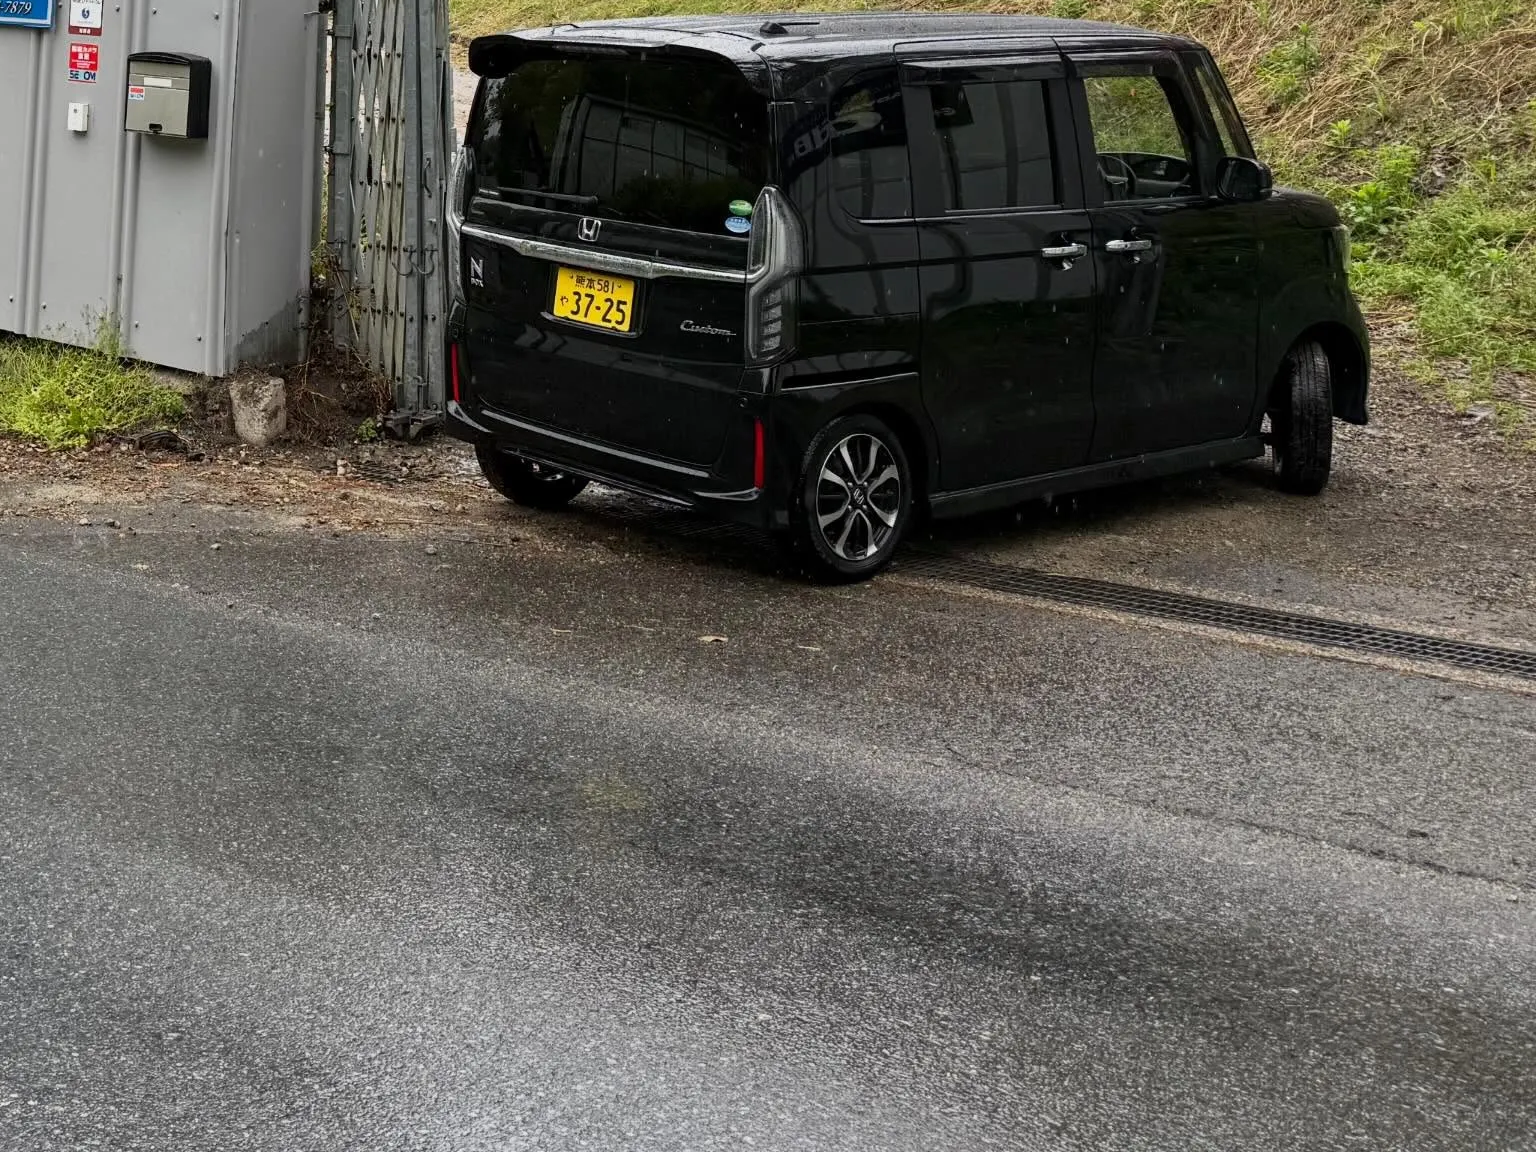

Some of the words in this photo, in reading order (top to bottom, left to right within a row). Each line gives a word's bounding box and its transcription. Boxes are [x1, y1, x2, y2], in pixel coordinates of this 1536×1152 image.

[69, 69, 96, 81] SEOM
[560, 295, 569, 307] や
[569, 290, 628, 326] 37-25
[679, 319, 737, 336] Custom
